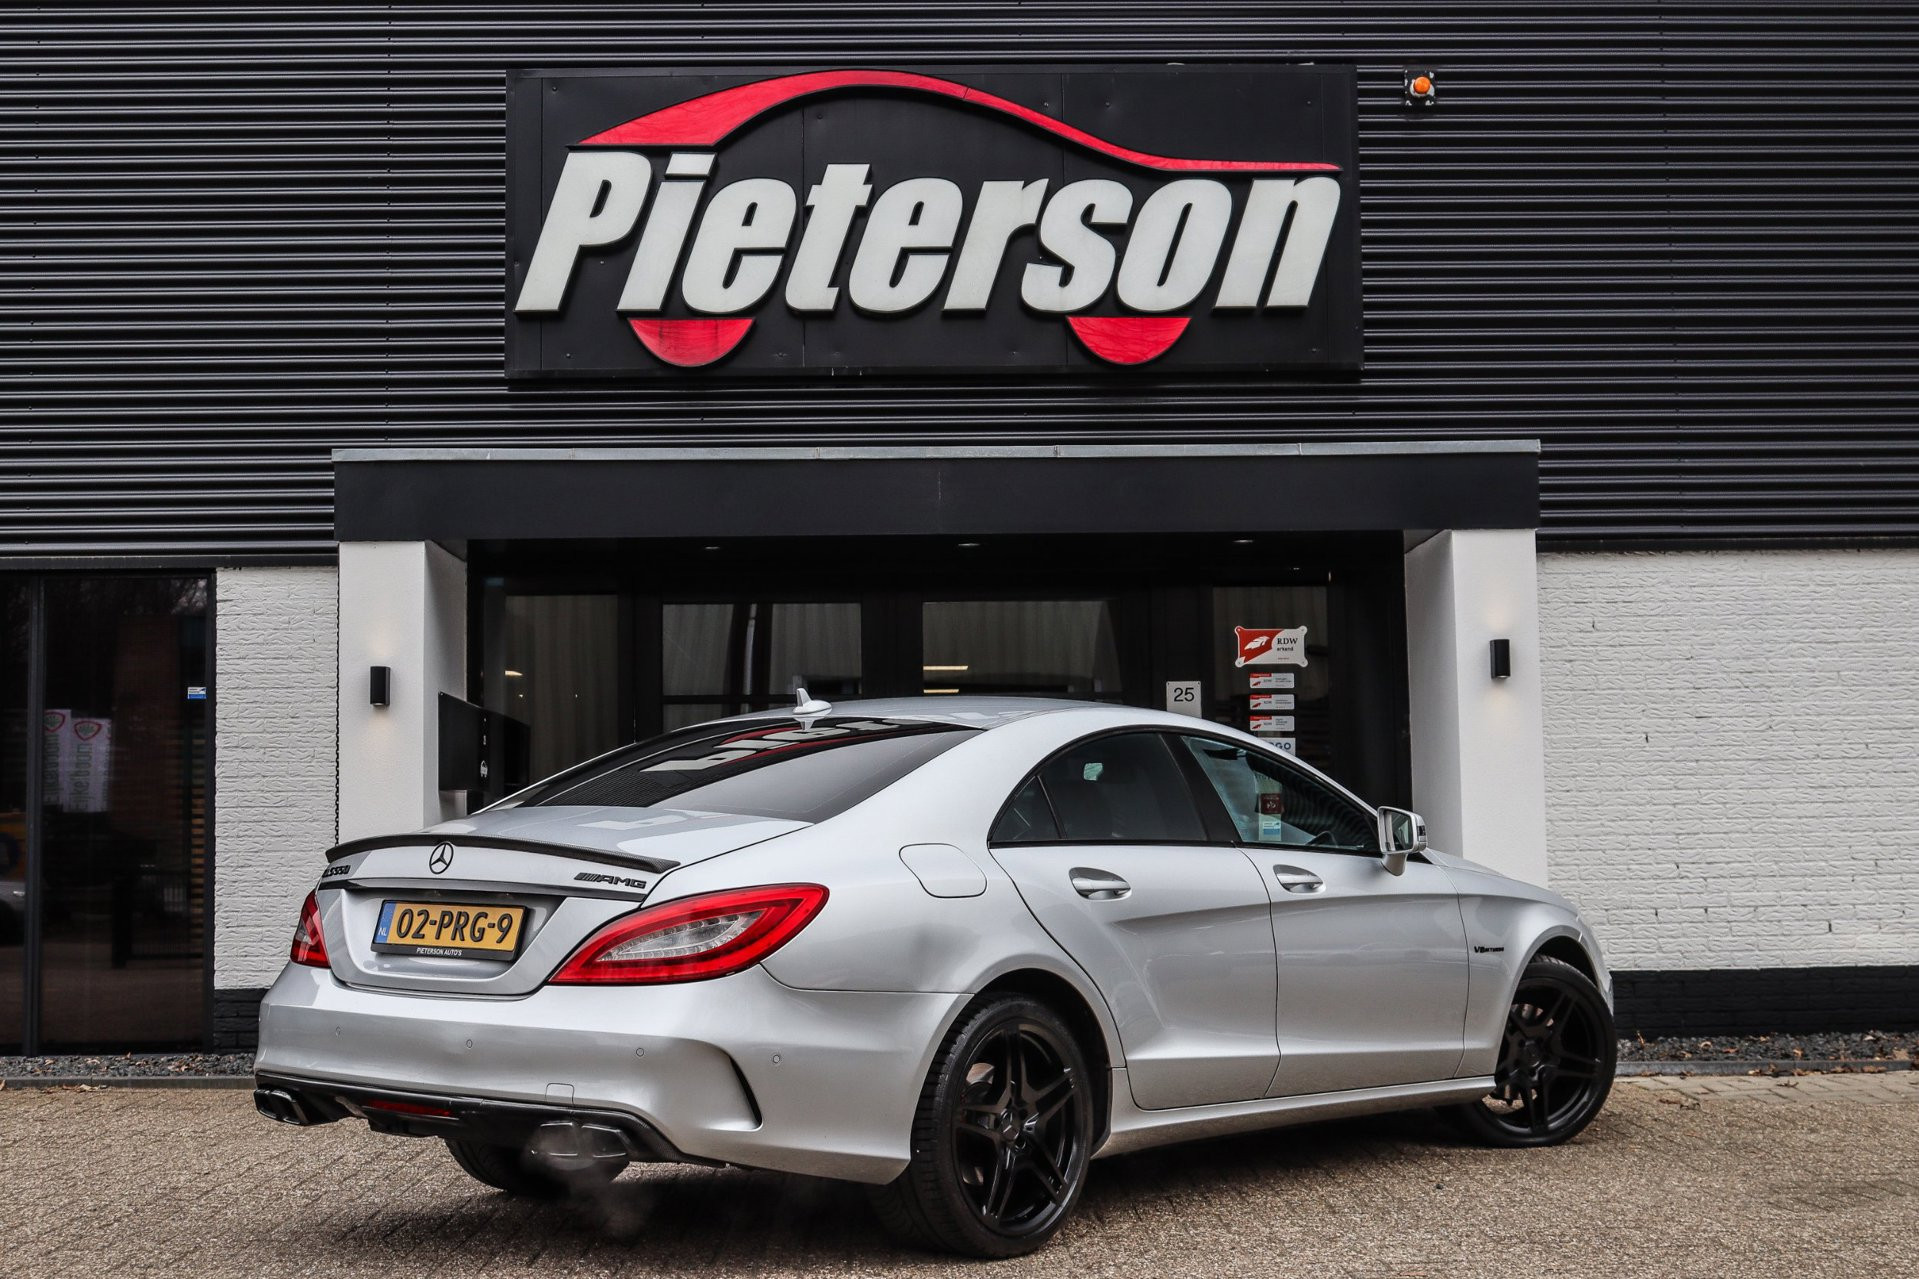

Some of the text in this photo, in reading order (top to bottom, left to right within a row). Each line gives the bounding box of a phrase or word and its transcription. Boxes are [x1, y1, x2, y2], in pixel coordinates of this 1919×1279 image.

[514, 151, 1342, 312] Pieterson
[1174, 687, 1195, 702] 25
[597, 874, 647, 889] AMG
[378, 927, 387, 937] NL
[396, 908, 513, 944] 02-PRG-9
[416, 947, 444, 955] PIETERSON
